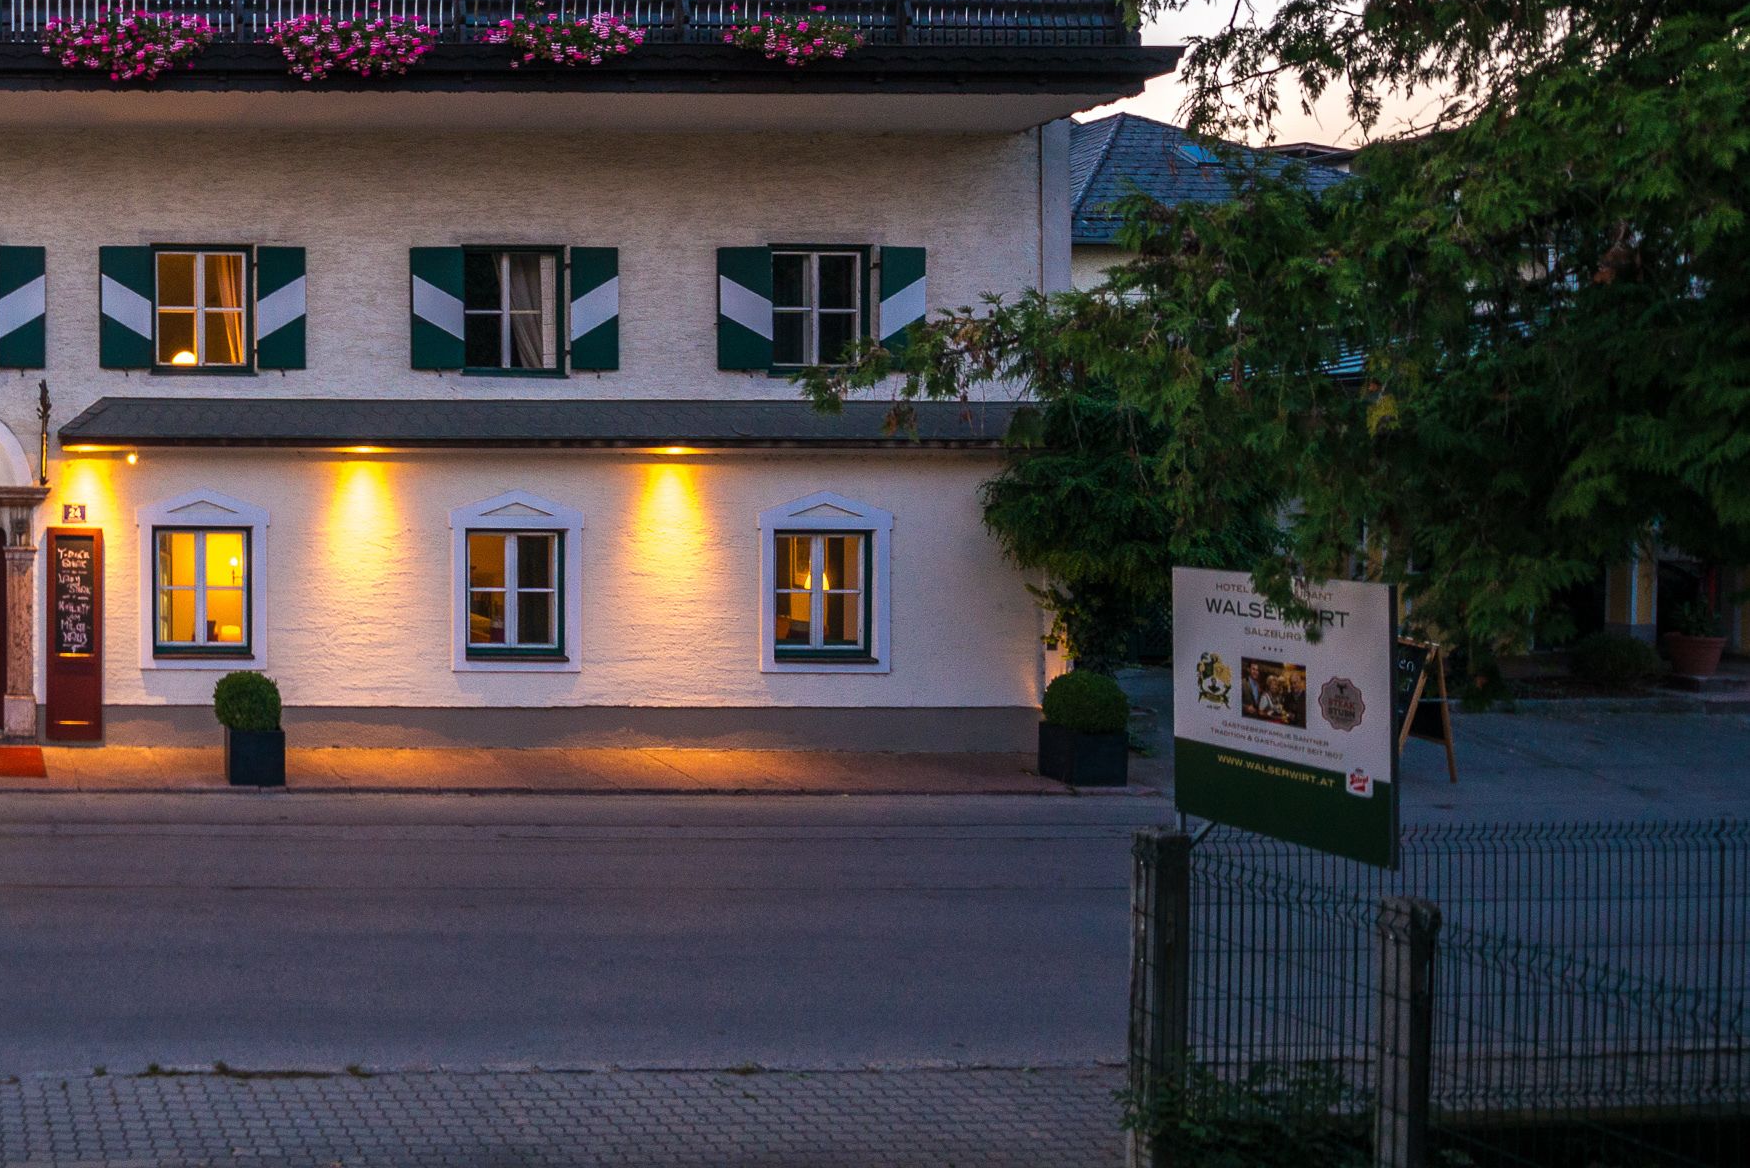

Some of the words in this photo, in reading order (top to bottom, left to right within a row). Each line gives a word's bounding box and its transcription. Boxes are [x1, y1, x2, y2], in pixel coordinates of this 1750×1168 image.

[68, 507, 82, 519] 24
[1215, 582, 1249, 593] HOTEL
[1244, 626, 1302, 641] SALZBURG
